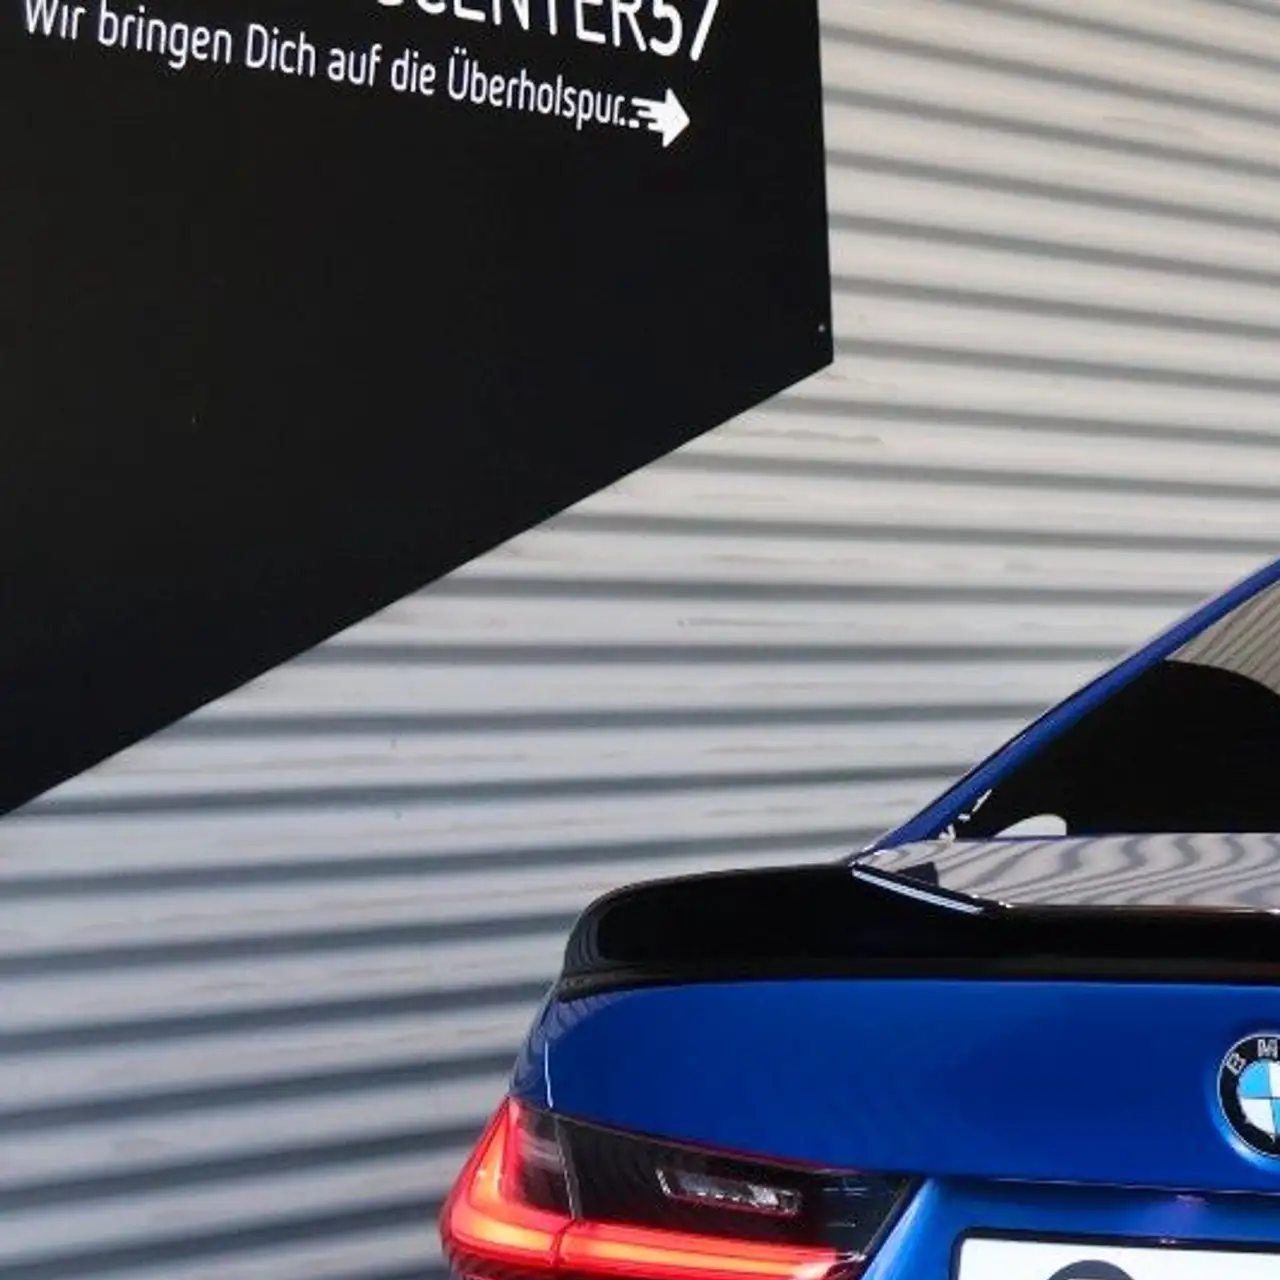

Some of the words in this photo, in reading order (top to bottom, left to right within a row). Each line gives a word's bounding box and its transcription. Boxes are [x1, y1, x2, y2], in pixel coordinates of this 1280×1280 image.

[25, 0, 85, 40] Wir
[98, 6, 232, 69] bringen
[245, 23, 316, 77] Dich
[327, 44, 383, 86] auf
[390, 48, 436, 95] die
